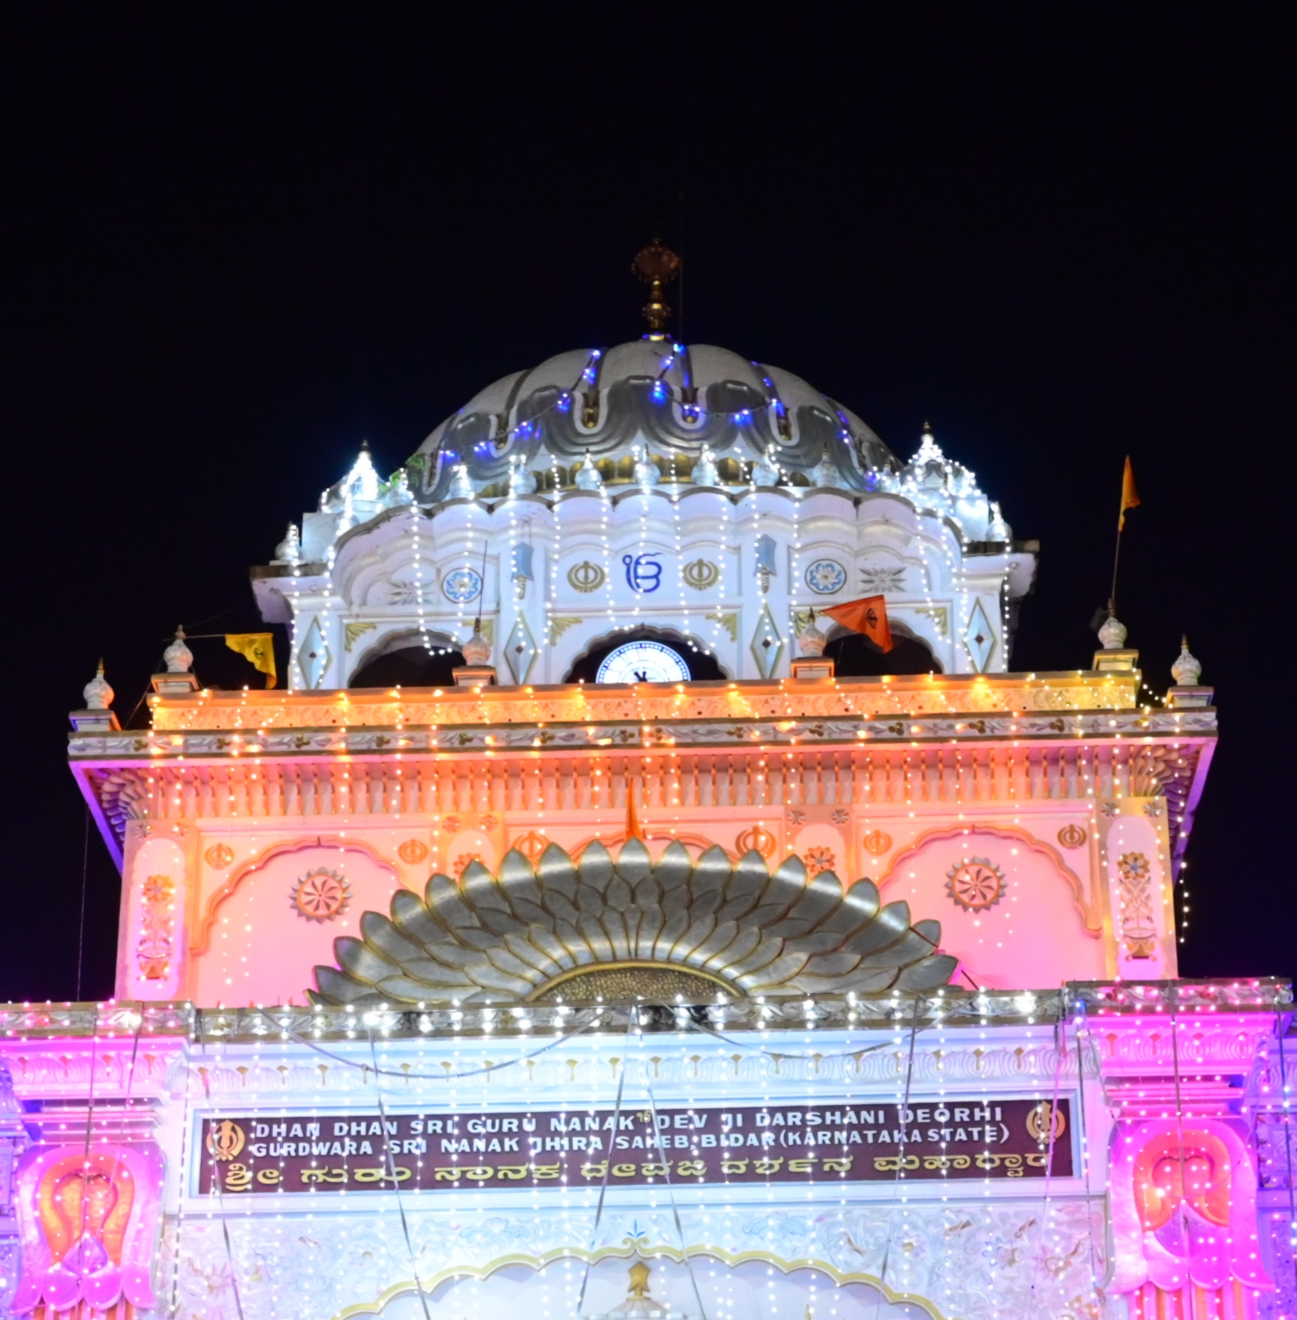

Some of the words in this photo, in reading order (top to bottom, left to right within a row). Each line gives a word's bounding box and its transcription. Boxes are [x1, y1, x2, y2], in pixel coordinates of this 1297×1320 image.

[256, 1122, 320, 1138] DHAN
[334, 1121, 398, 1137] DHAN
[410, 1119, 453, 1135] SRI
[467, 1117, 537, 1134] GURU
[550, 1115, 634, 1132] NANAK
[657, 1113, 707, 1129] DEV
[721, 1113, 744, 1131] JI
[755, 1110, 885, 1127] DARSHANI
[898, 1106, 1002, 1124] DEORHI
[252, 1140, 373, 1158] GURDWARA
[388, 1138, 427, 1154] SRI
[441, 1136, 520, 1154] NANAK
[531, 1135, 604, 1154] JHIRA
[225, 1162, 281, 1192] ಶ್ರೀ
[300, 1164, 413, 1184] ಗುರು
[434, 1161, 561, 1182] ನಾನಕ
